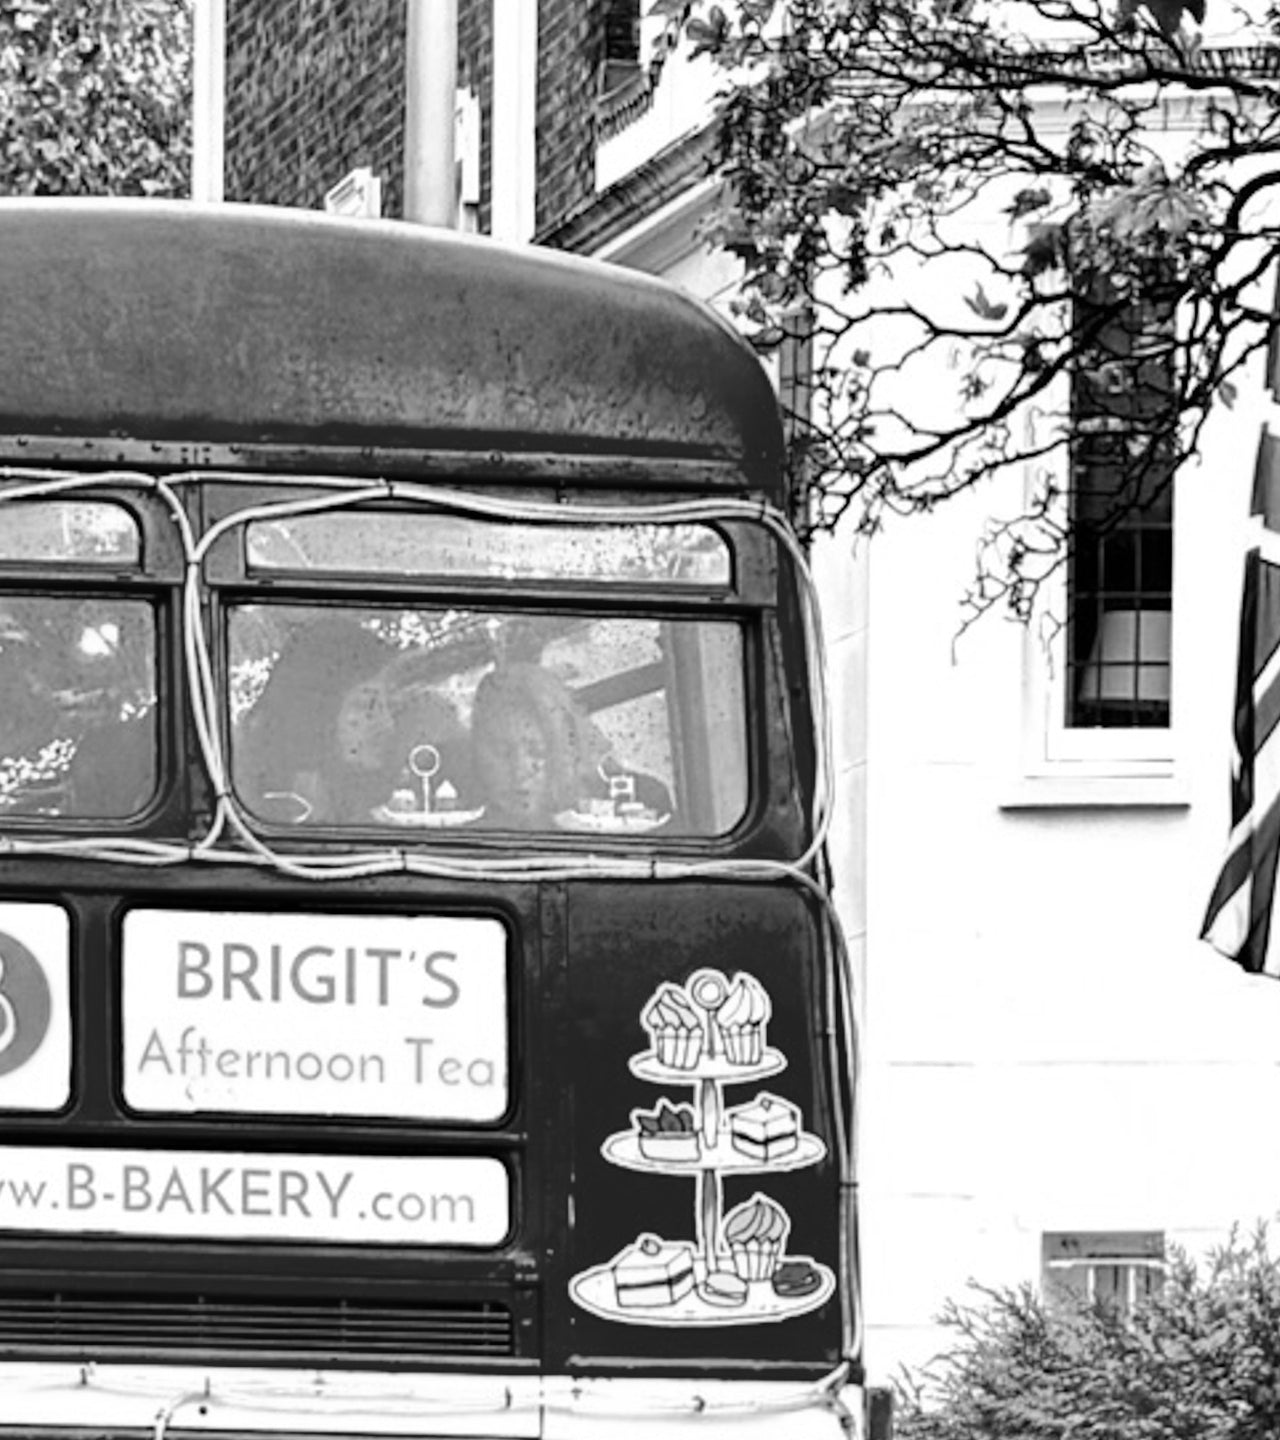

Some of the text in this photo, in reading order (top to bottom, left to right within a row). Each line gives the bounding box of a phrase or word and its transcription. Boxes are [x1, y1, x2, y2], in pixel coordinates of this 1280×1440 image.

[177, 940, 460, 1009] BRIGIT'S
[138, 1025, 495, 1087] Afternoon Tea
